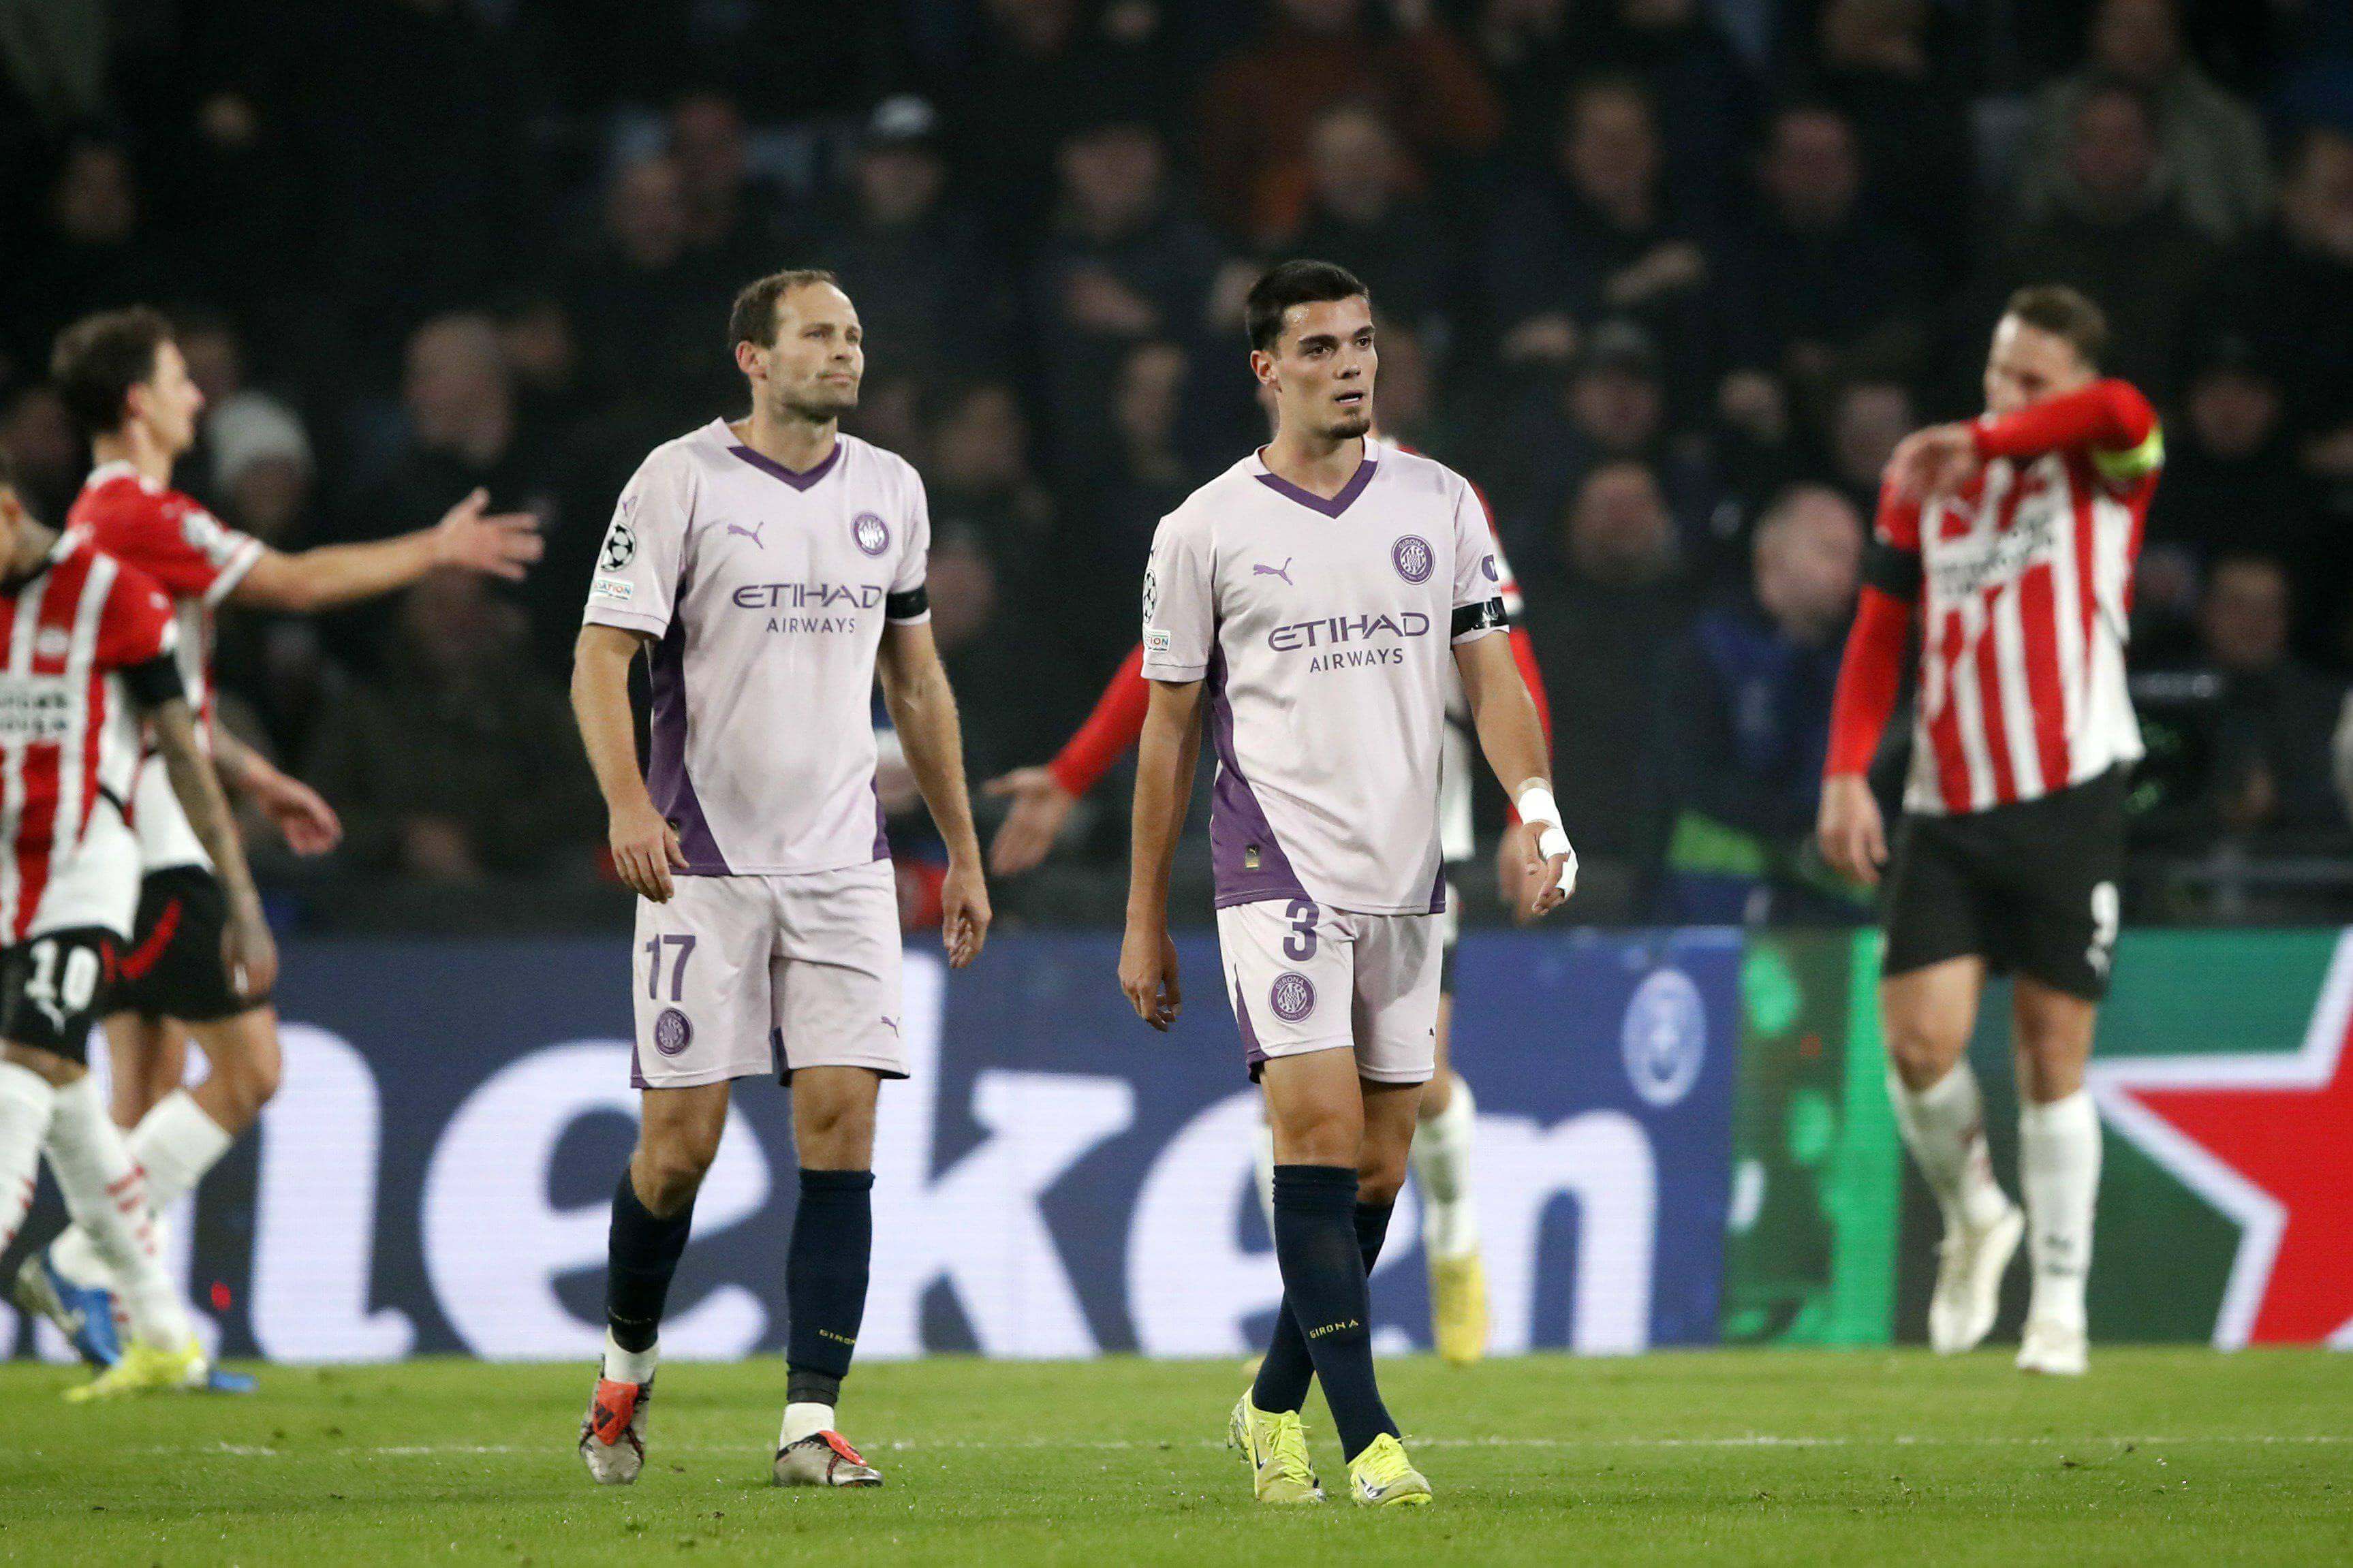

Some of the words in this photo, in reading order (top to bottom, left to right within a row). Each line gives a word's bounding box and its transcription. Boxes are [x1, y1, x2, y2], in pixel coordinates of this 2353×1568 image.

[732, 583, 882, 608] ETIHAD
[766, 617, 856, 633] AIRWAYS
[1268, 612, 1429, 652] ETIHAD
[1309, 648, 1403, 673] AIRWAYS
[1283, 898, 1320, 962] 3
[25, 938, 99, 1011] 10
[646, 934, 696, 1001] 17
[1275, 976, 1305, 989] GIRONA
[0, 949, 1657, 1364] neken
[1309, 1319, 1358, 1338] GIRONA
